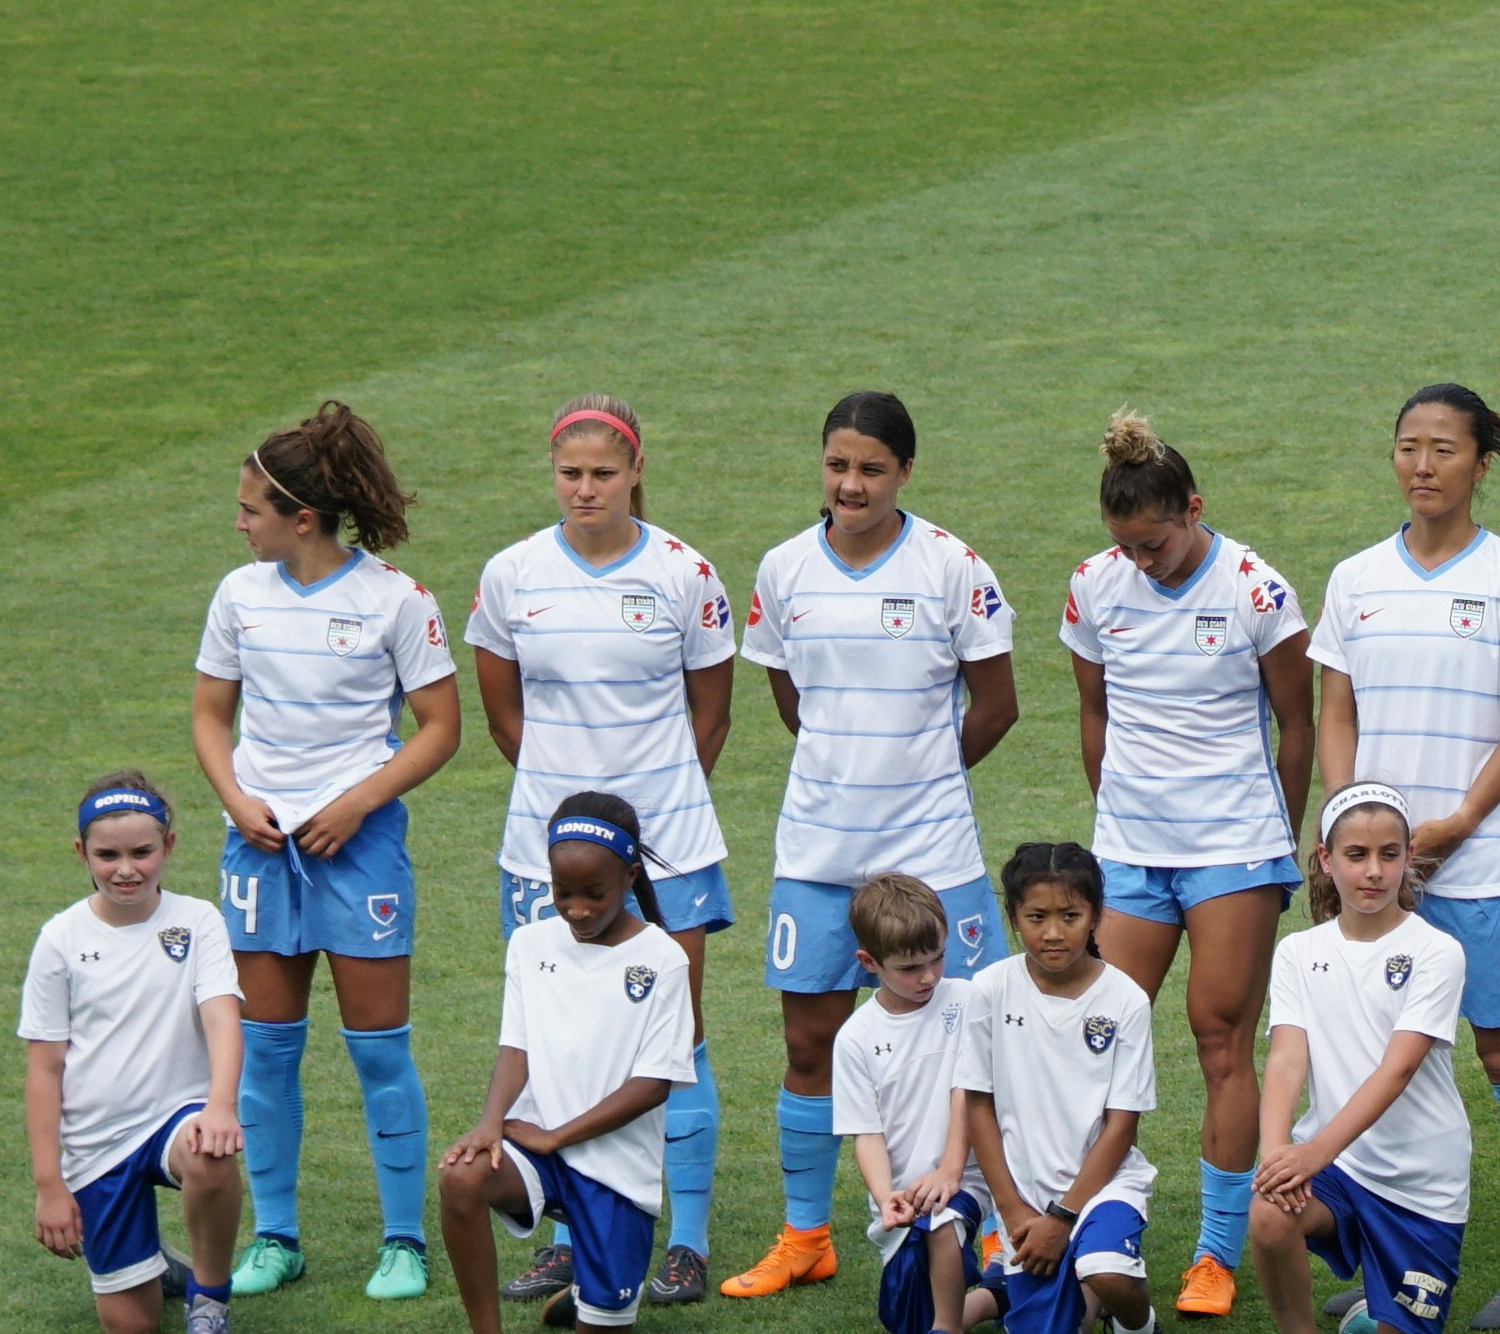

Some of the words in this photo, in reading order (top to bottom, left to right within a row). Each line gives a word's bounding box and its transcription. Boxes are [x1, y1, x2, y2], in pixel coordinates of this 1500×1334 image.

[94, 793, 150, 809] SOPHIA
[557, 822, 615, 841] LONDYN
[767, 907, 798, 971] 0
